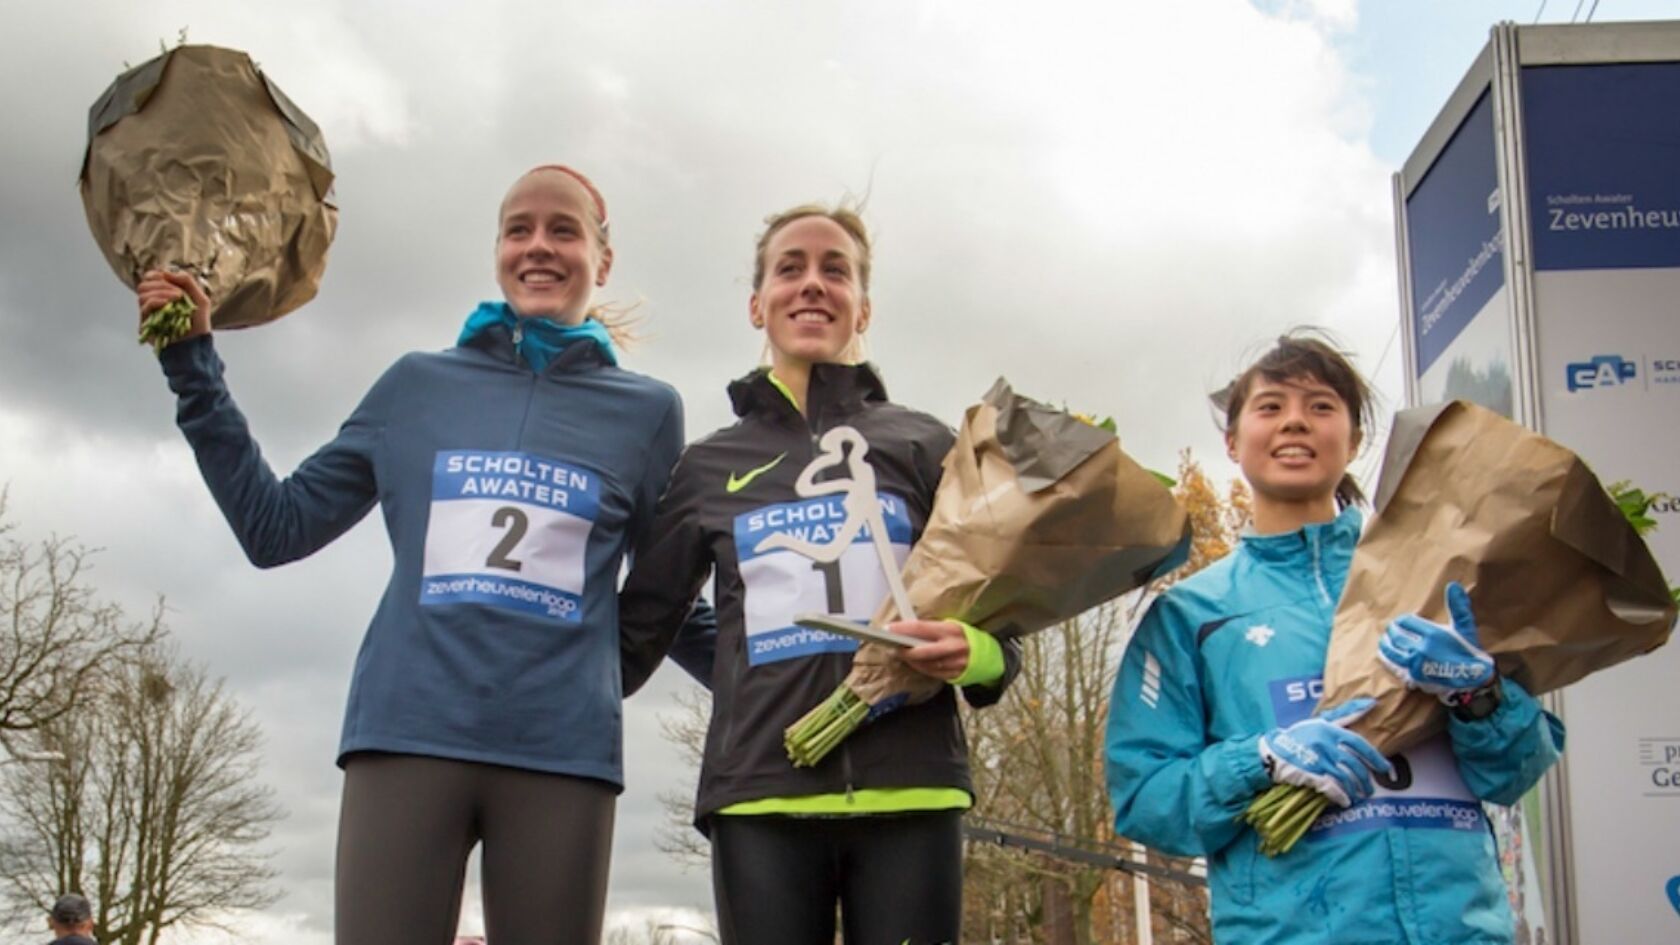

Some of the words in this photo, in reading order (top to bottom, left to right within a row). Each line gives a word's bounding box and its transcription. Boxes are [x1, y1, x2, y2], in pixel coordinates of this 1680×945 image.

[1549, 205, 1680, 231] Zevenheu
[447, 455, 587, 491] SCHOLTEN
[461, 477, 569, 507] AWATER
[748, 499, 896, 532] SCHOLN
[485, 506, 529, 573] 2
[427, 576, 577, 612] zevenheuvelenloop
[811, 556, 845, 614] 1
